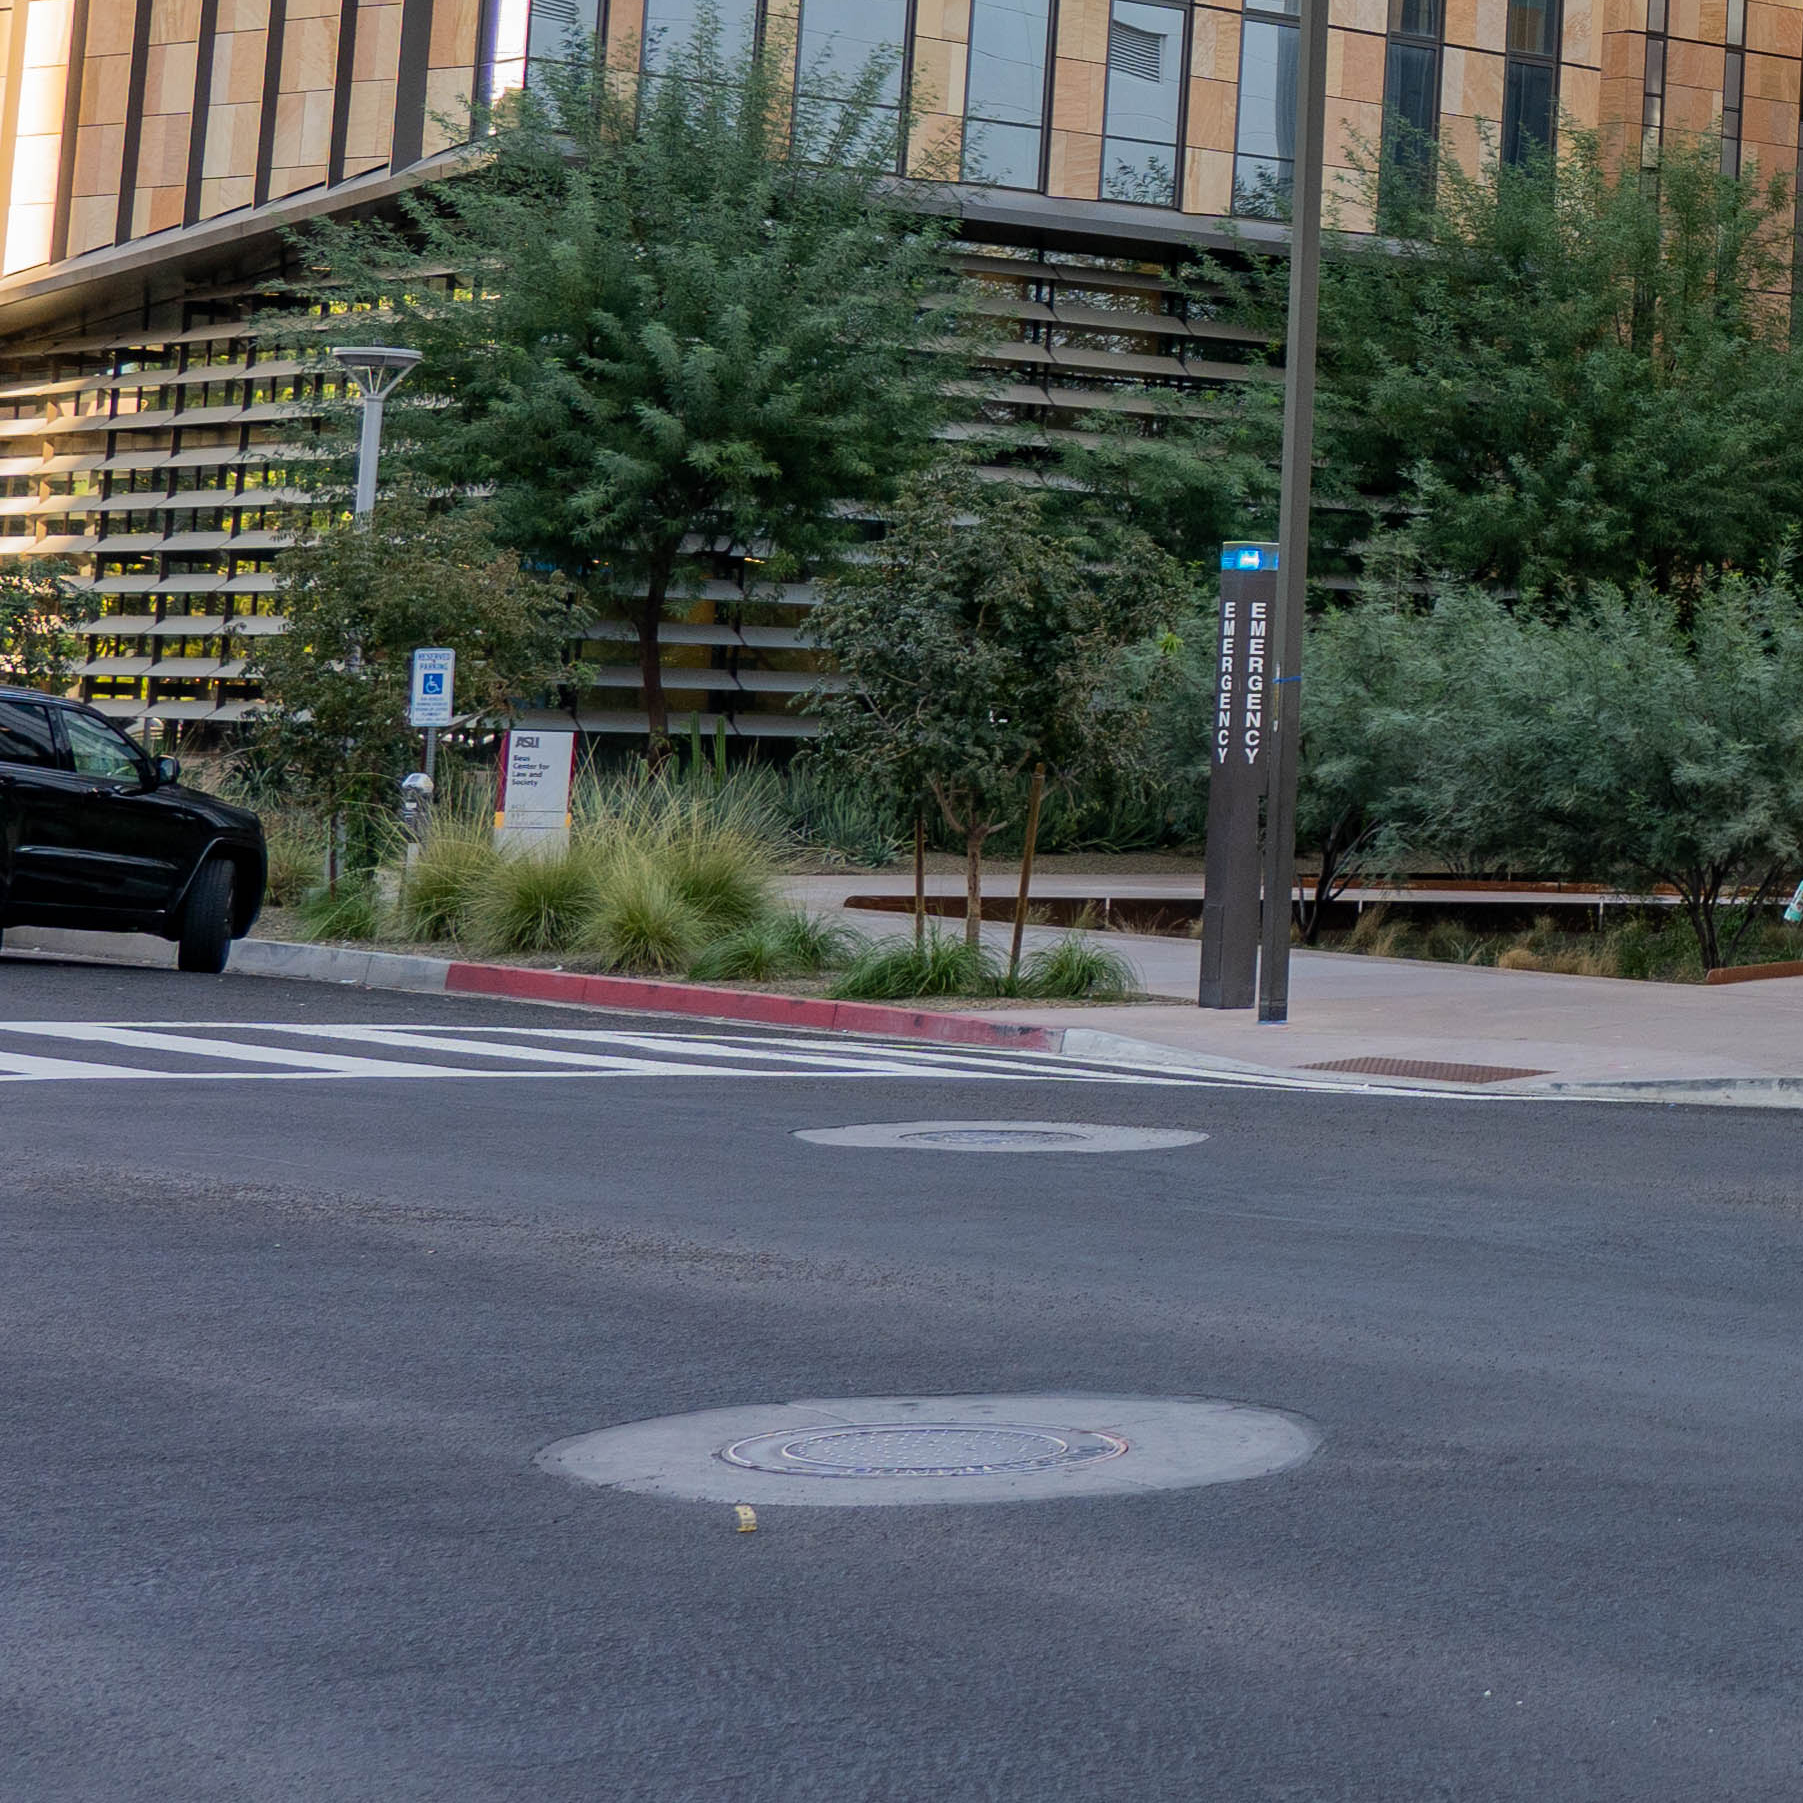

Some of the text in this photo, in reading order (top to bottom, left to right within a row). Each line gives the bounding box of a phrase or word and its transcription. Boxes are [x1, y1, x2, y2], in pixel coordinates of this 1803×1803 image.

[1217, 601, 1236, 764] EMERGENCY
[1244, 601, 1266, 765] EMERGENCY
[511, 778, 538, 787] Society
[515, 736, 540, 748] ASU
